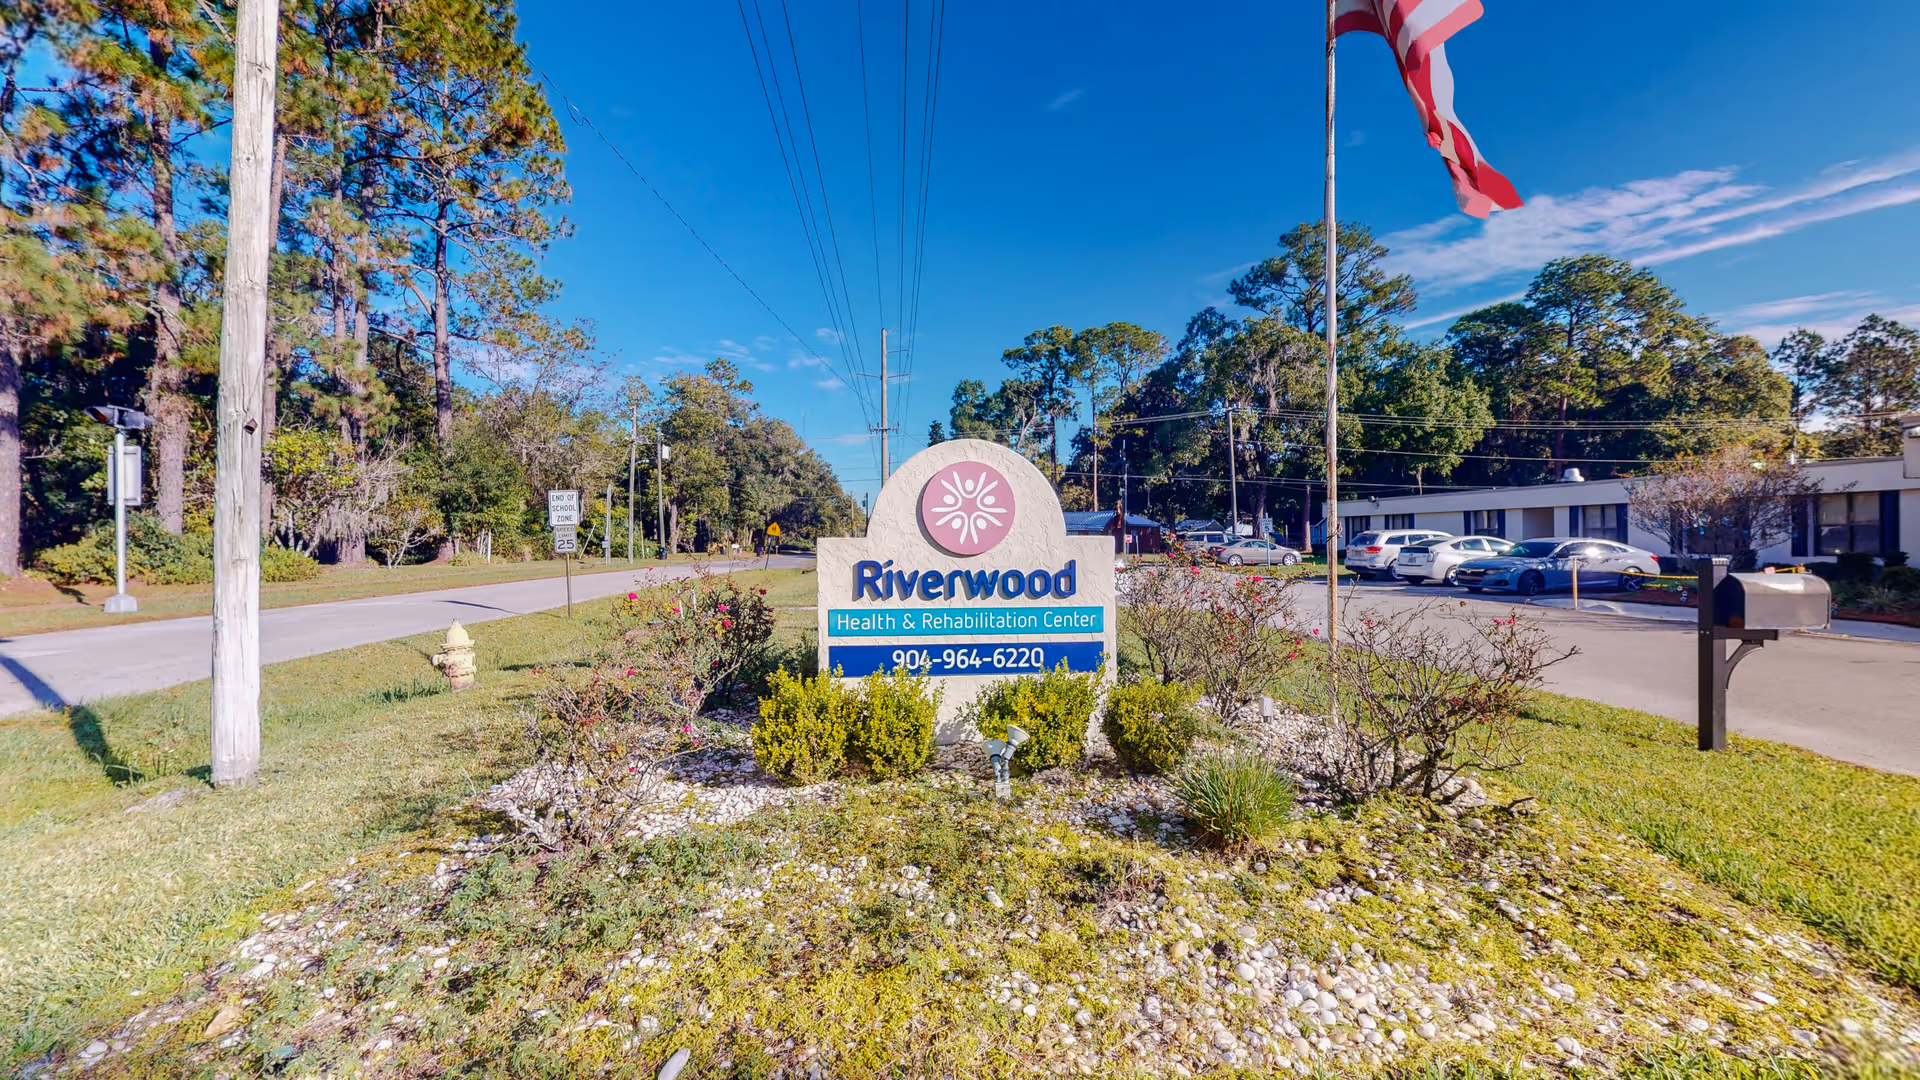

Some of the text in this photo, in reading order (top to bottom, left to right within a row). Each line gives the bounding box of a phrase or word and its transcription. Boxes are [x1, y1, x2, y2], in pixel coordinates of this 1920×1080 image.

[557, 539, 574, 549] 25
[853, 559, 1077, 600] Riverwood
[837, 611, 1097, 630] Health & Rehabilitation Center
[892, 647, 1045, 670] 904-964-6220
